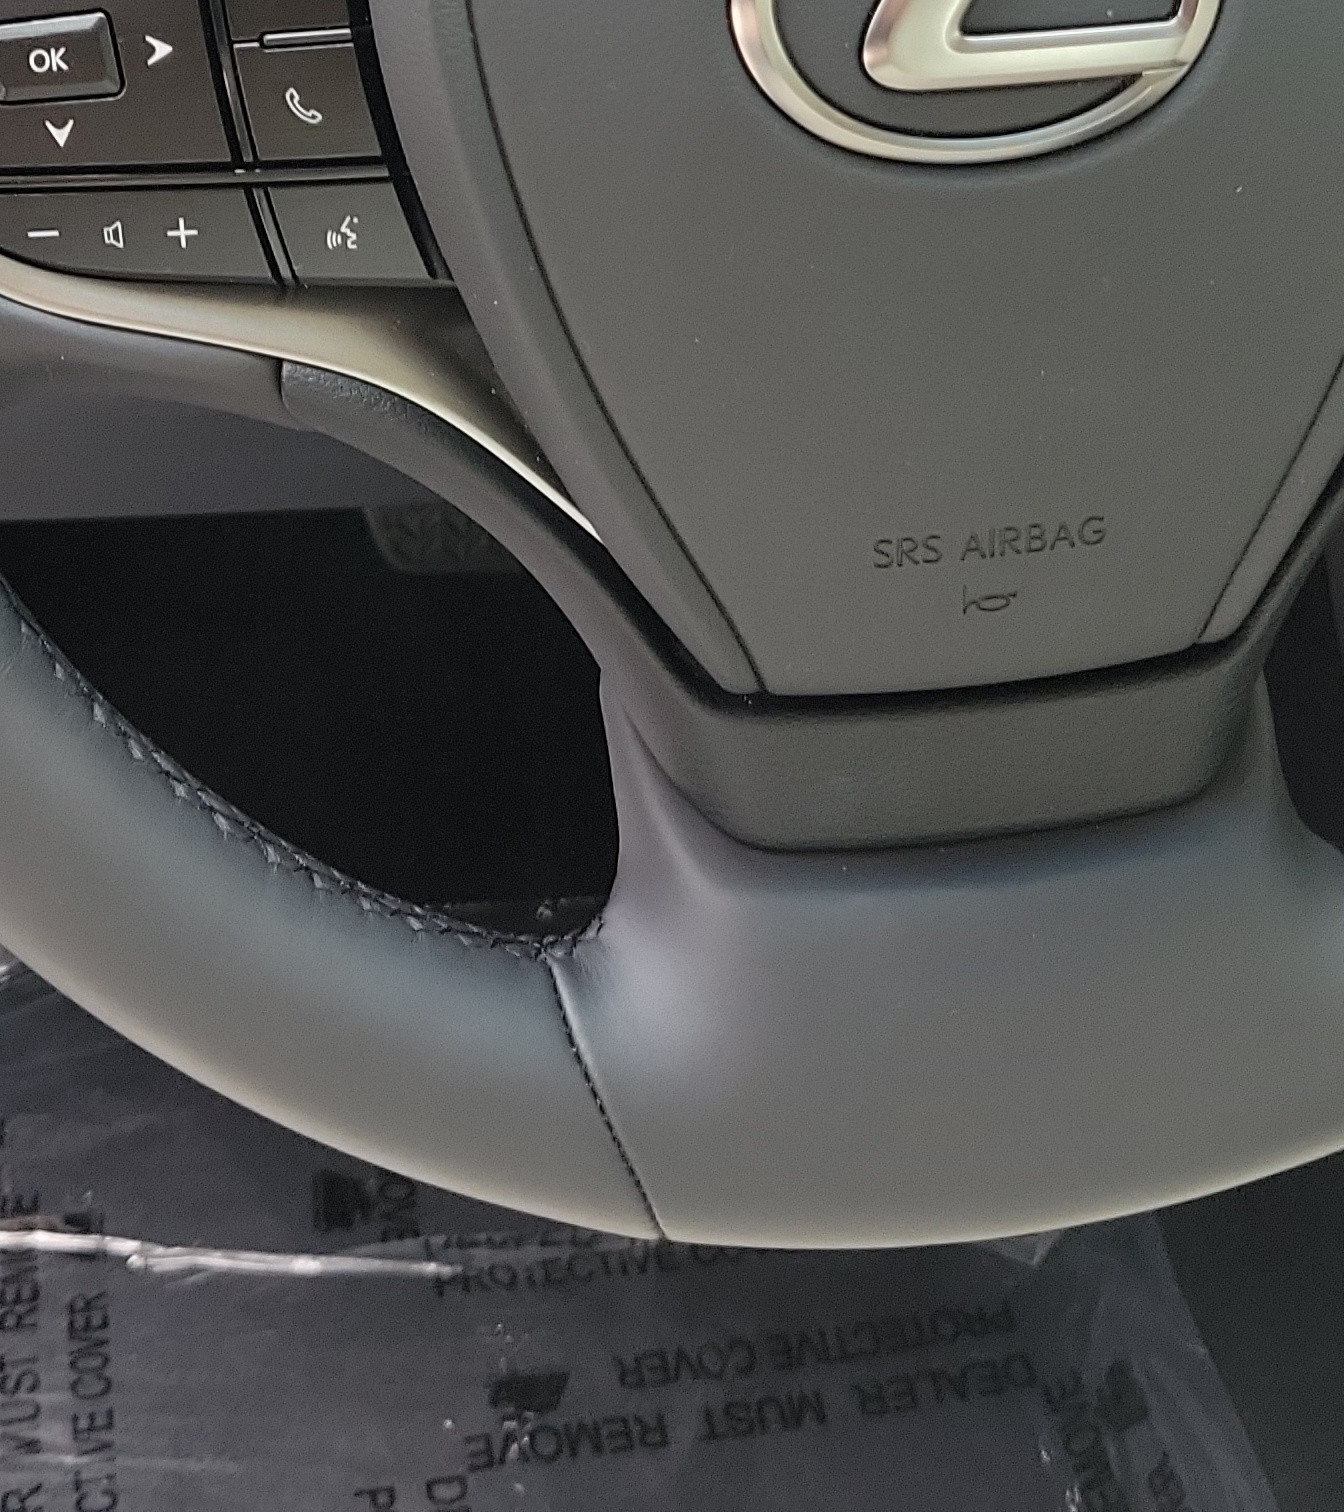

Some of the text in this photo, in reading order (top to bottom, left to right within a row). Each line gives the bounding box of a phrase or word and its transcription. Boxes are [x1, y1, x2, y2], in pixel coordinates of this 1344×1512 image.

[28, 47, 70, 74] OK
[872, 515, 1108, 570] SRS AIRBAG
[65, 1291, 112, 1401] COVER
[612, 1337, 759, 1392] COVER
[461, 1350, 1038, 1473] DEALER MUST REMOVE
